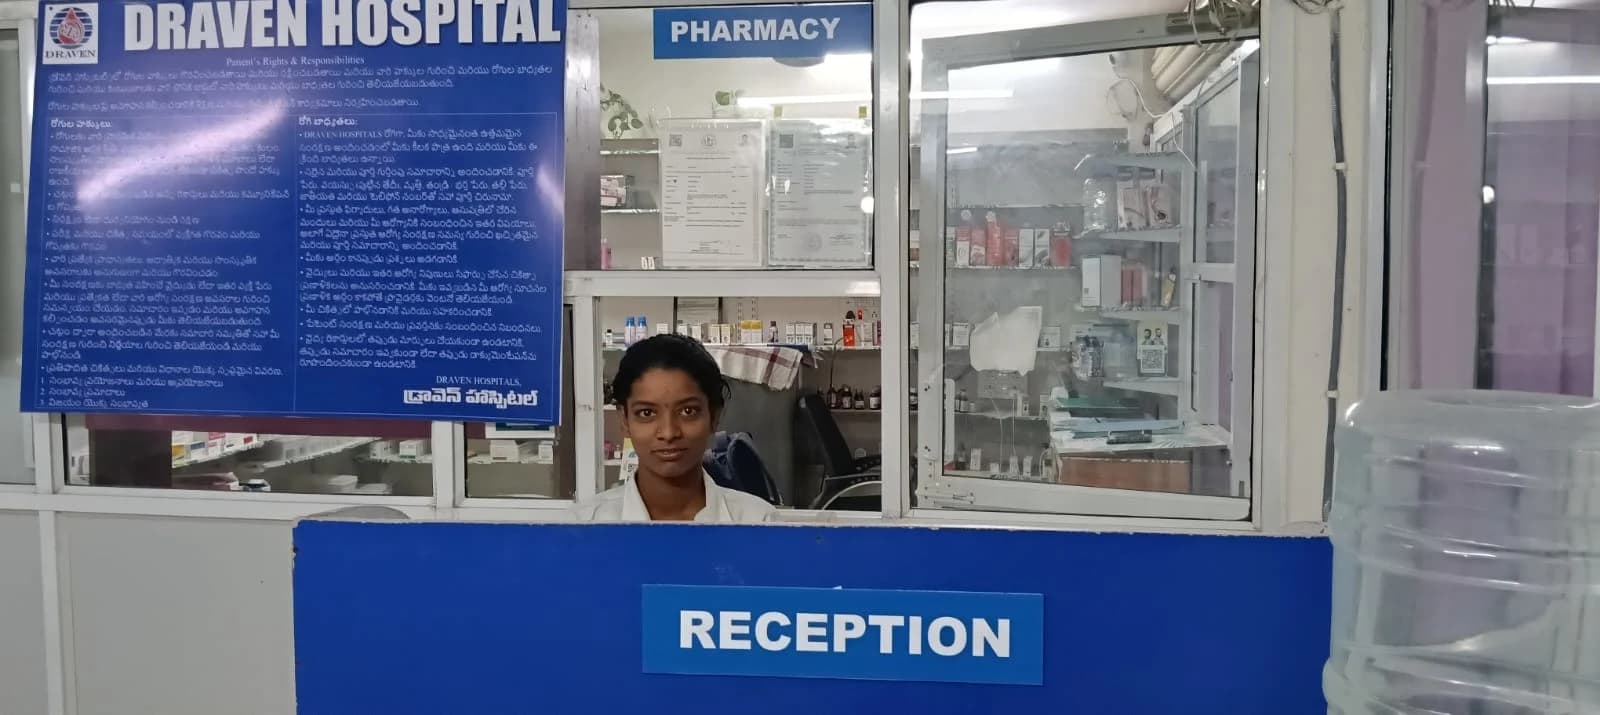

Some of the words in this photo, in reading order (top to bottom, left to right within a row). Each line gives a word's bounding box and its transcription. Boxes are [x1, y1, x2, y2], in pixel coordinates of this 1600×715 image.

[124, 0, 307, 51] DRAVEN
[321, 0, 561, 46] HOSPITAL
[671, 17, 841, 42] PHARMACY
[45, 50, 96, 58] DRAVEN
[263, 57, 288, 68] Rights
[290, 57, 298, 66] &
[301, 56, 365, 68] Responsibilities
[436, 375, 473, 385] DRAVEN
[403, 387, 461, 405] డ్రావెన్
[465, 389, 539, 409] హాస్పిటల్
[680, 609, 1011, 658] RECEPTION
